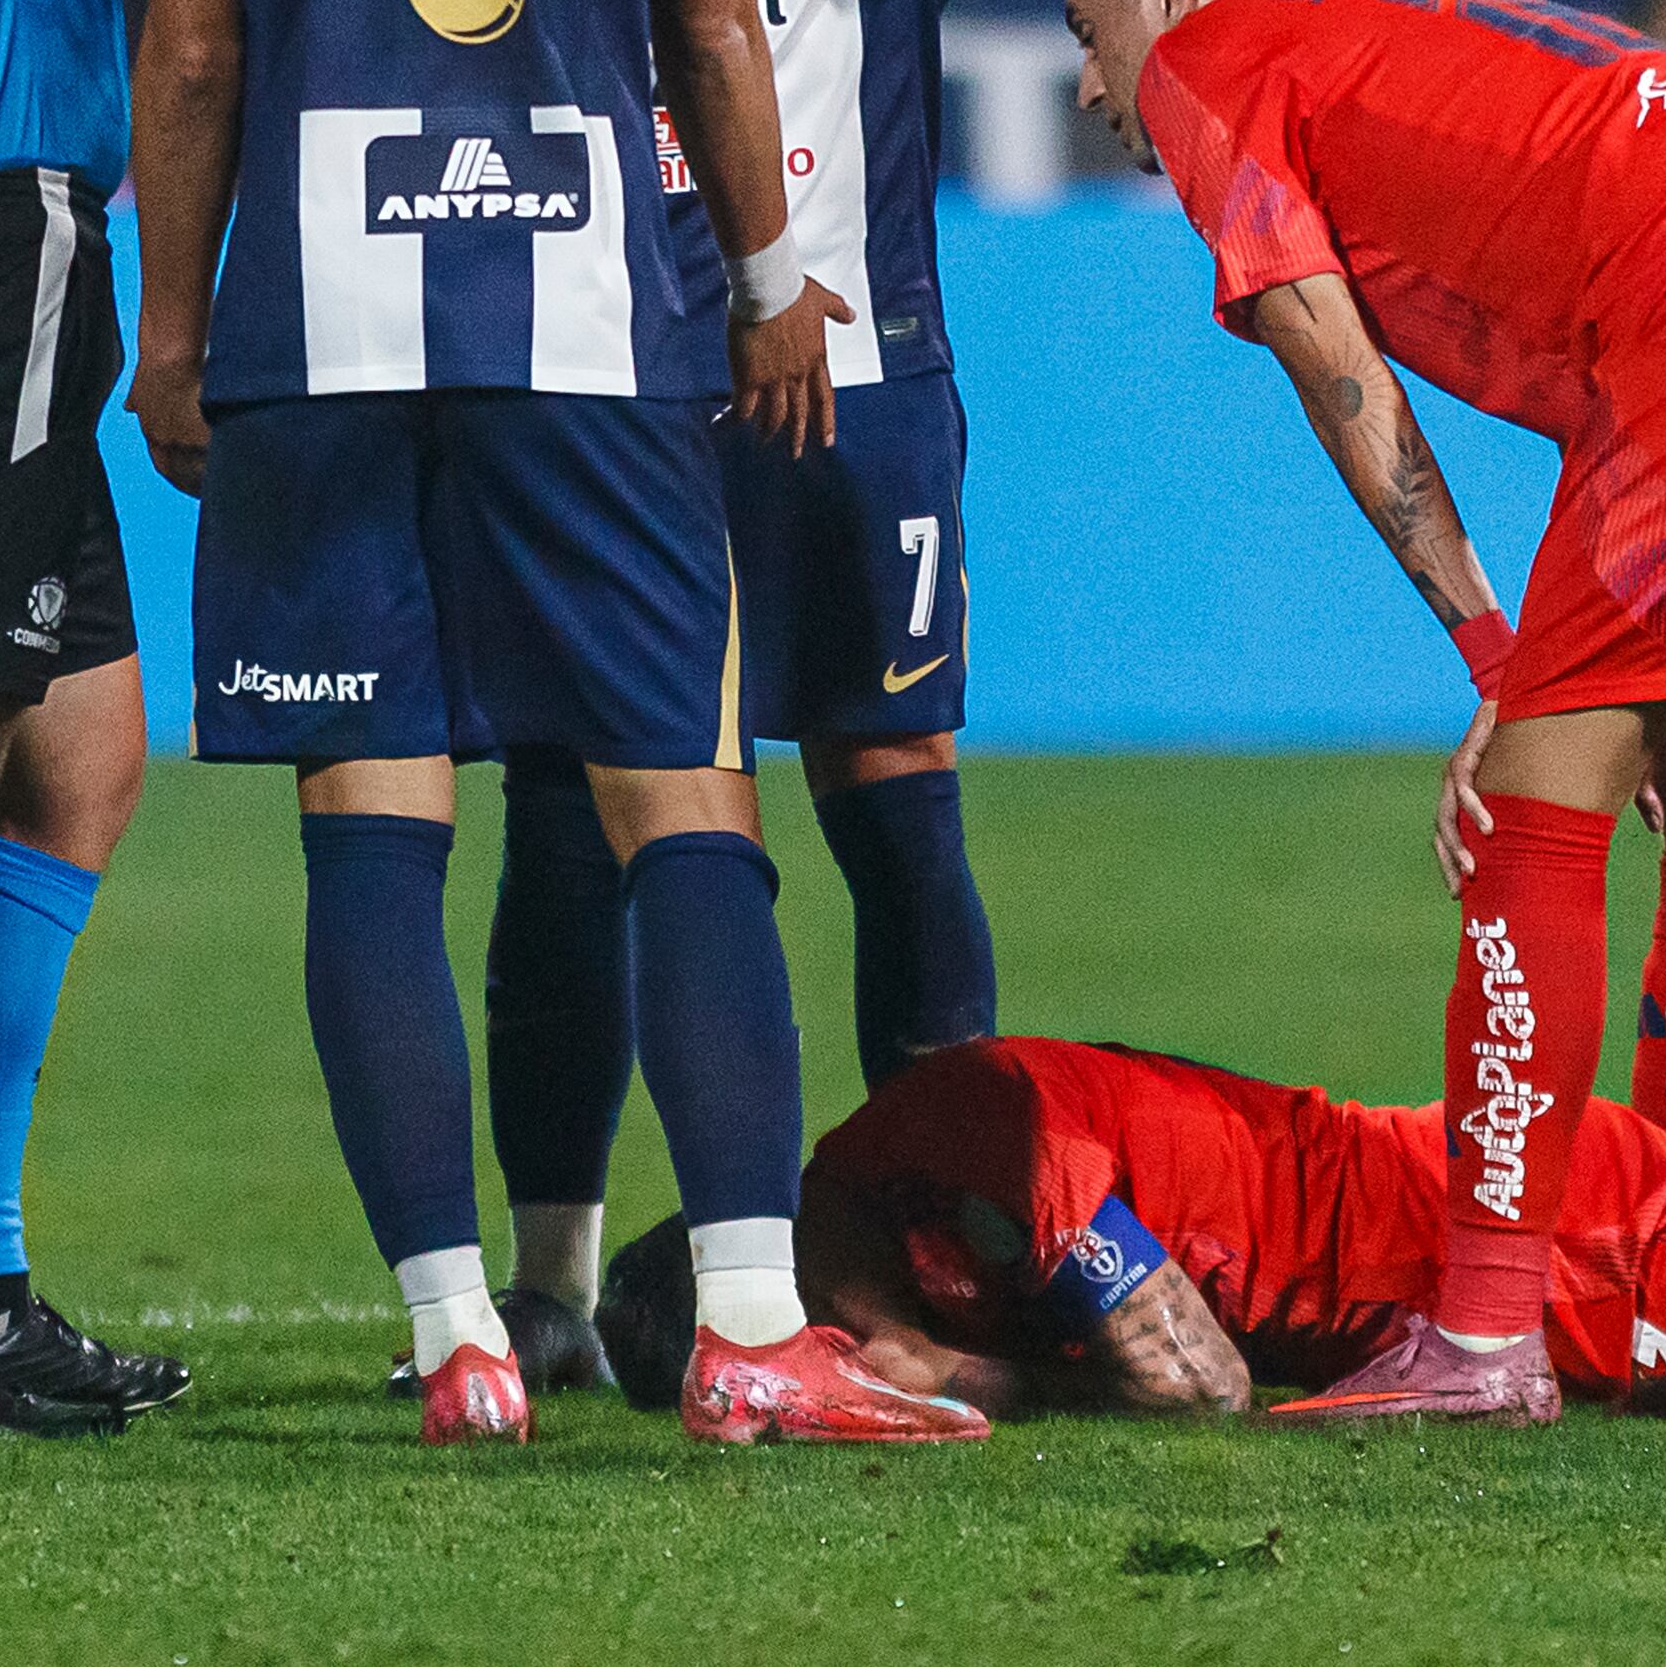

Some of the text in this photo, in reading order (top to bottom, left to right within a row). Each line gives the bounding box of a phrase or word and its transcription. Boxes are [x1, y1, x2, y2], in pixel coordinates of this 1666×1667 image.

[377, 193, 577, 221] ANYPSA
[899, 516, 939, 636] 7
[219, 660, 379, 702] JetSMART
